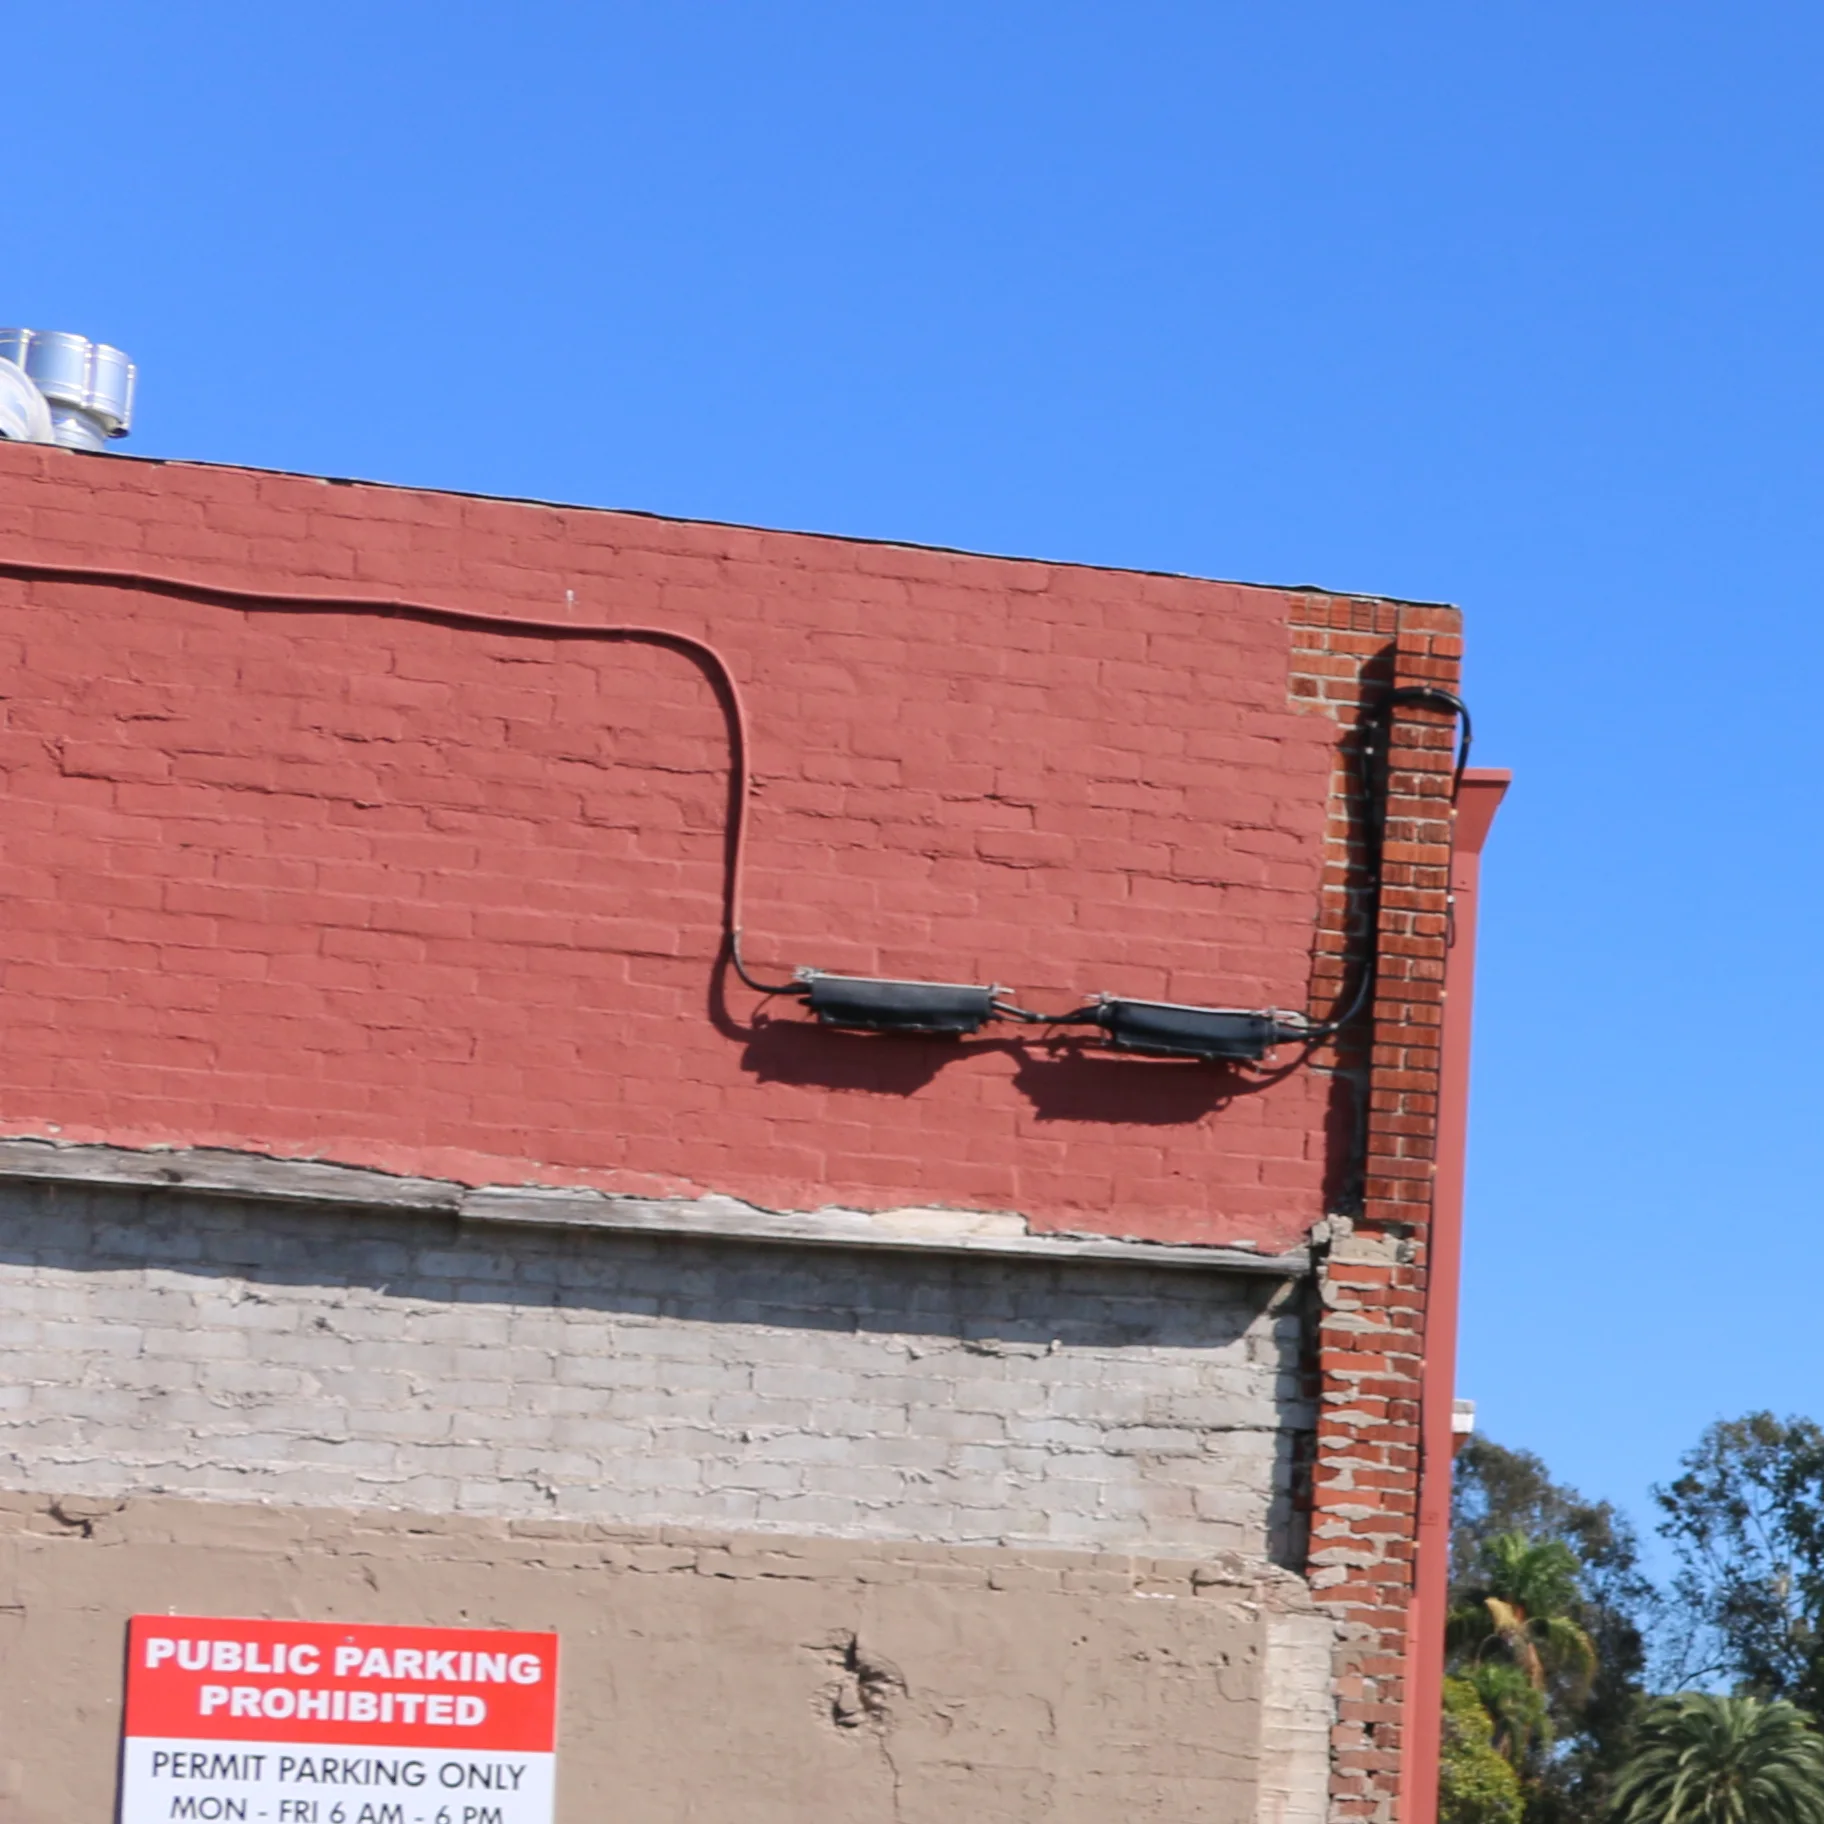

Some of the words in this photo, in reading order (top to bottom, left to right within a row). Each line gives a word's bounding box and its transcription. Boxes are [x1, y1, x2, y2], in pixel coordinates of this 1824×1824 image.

[146, 1638, 319, 1675] PUBLIC
[335, 1646, 540, 1684] PARKING
[200, 1685, 486, 1725] PROHIBITED
[152, 1750, 267, 1781] PERMIT
[279, 1755, 427, 1788] PARKING
[438, 1761, 526, 1791] ONLY
[170, 1795, 247, 1821] MON
[279, 1799, 318, 1824] FRI
[329, 1801, 346, 1824] 6
